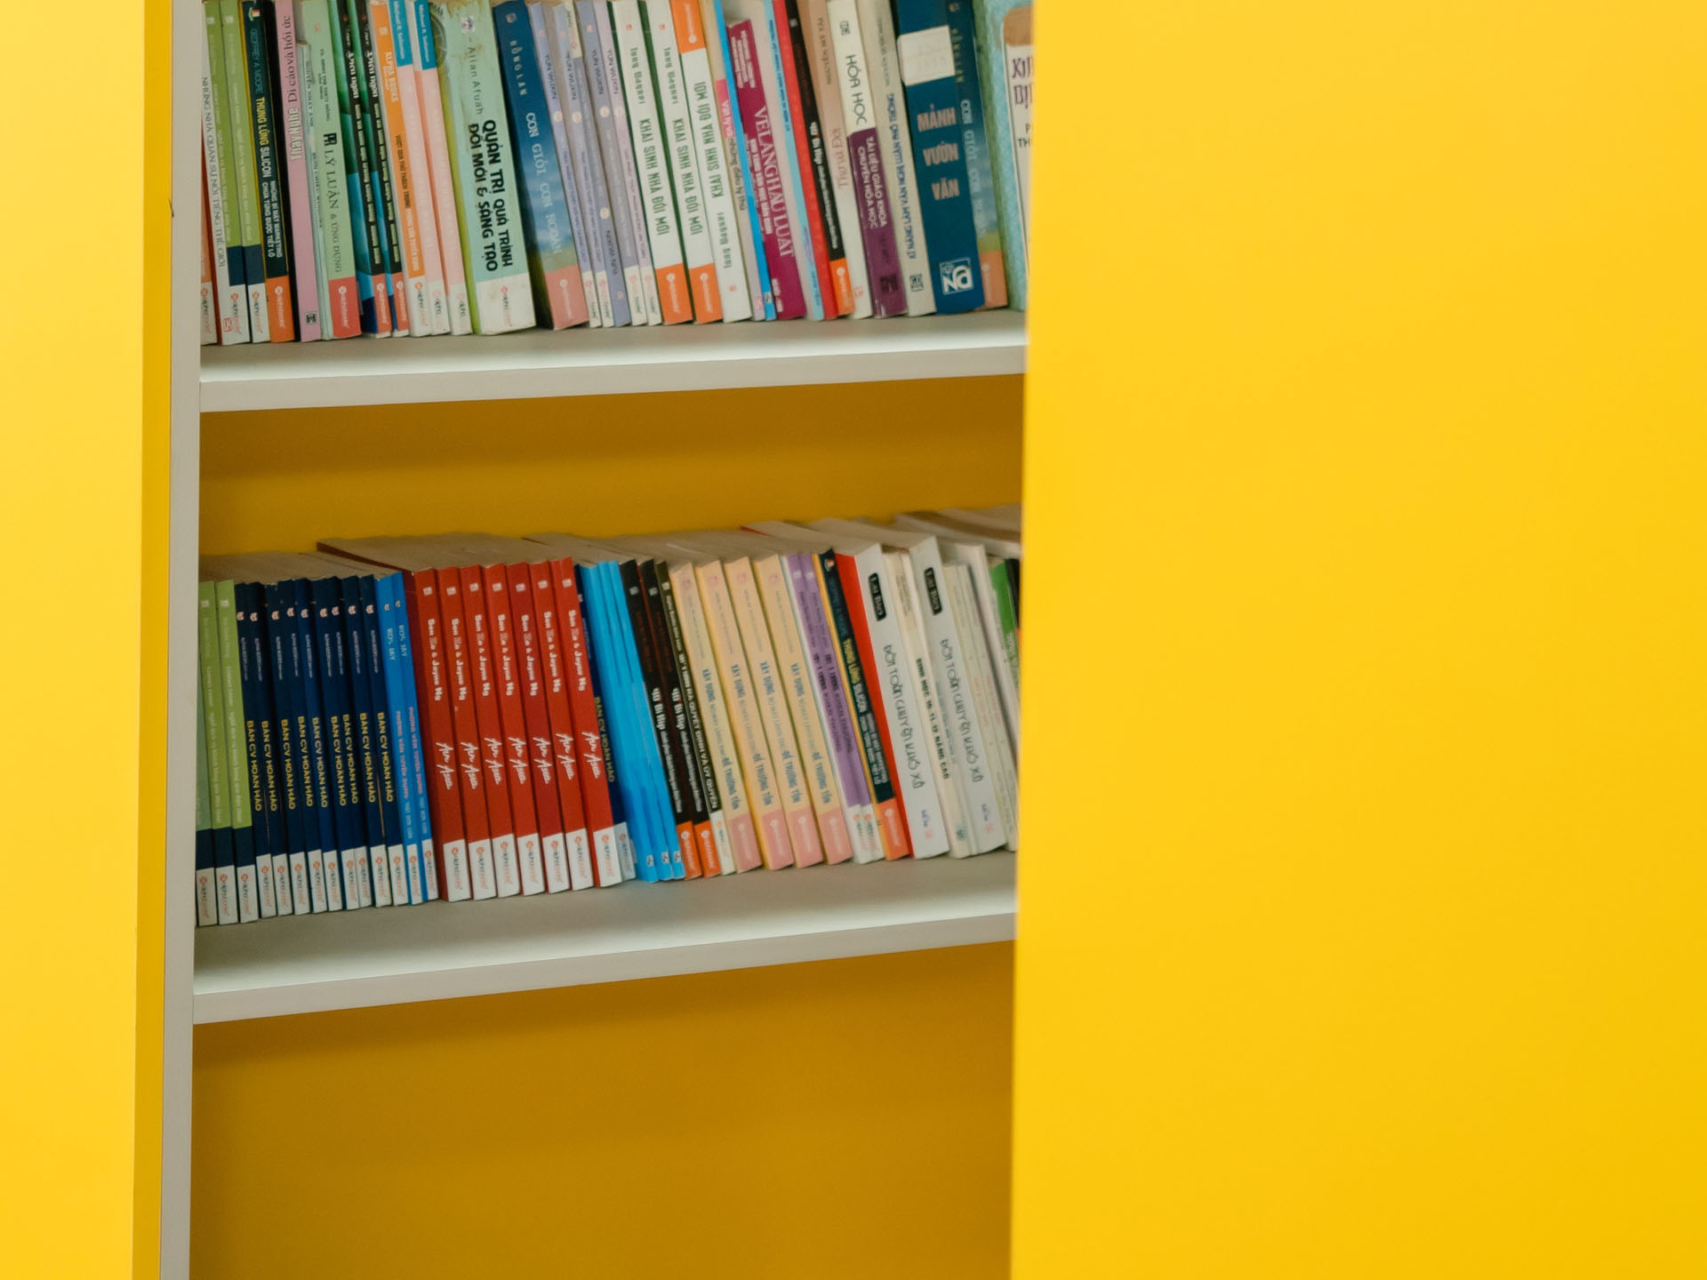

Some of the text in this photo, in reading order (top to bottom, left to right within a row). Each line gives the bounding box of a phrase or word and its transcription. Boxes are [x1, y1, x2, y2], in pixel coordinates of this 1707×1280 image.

[467, 47, 484, 115] Allan Afuah
[845, 54, 861, 88] HÓA
[256, 97, 267, 122] THUNG
[639, 118, 653, 142] KHAI
[260, 146, 272, 177] SILICON
[324, 149, 336, 165] LÝ
[472, 153, 487, 182] MỚI
[643, 145, 658, 169] SINH
[326, 170, 340, 208] LUẬN
[478, 201, 494, 238] SÁNG
[490, 168, 505, 193] TRỊ
[498, 229, 513, 266] TRÌNH
[483, 242, 497, 271] TẠO
[264, 743, 271, 758] CV
[362, 735, 370, 749] CV
